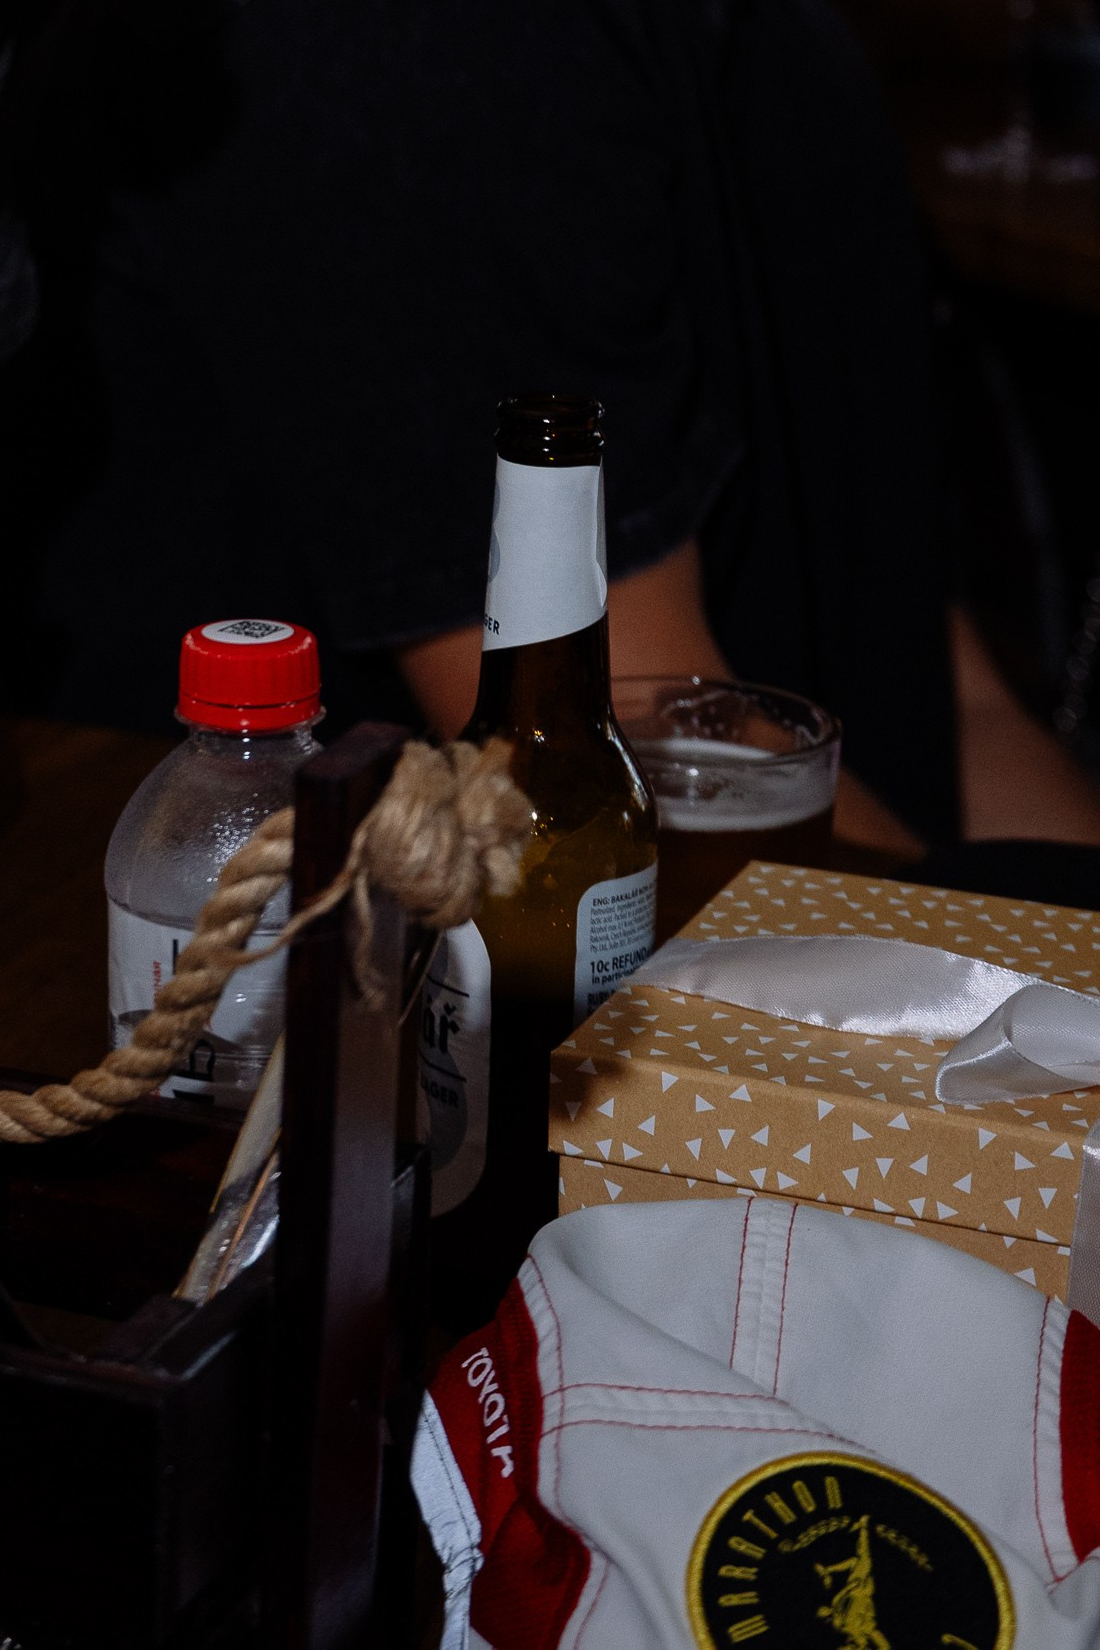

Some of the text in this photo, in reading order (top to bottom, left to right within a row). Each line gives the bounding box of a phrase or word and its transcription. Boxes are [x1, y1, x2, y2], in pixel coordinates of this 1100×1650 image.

[590, 959, 610, 974] 10c
[612, 947, 647, 971] REFUND
[461, 1346, 516, 1479] TOYOTA
[717, 1475, 845, 1645] MARATHON
